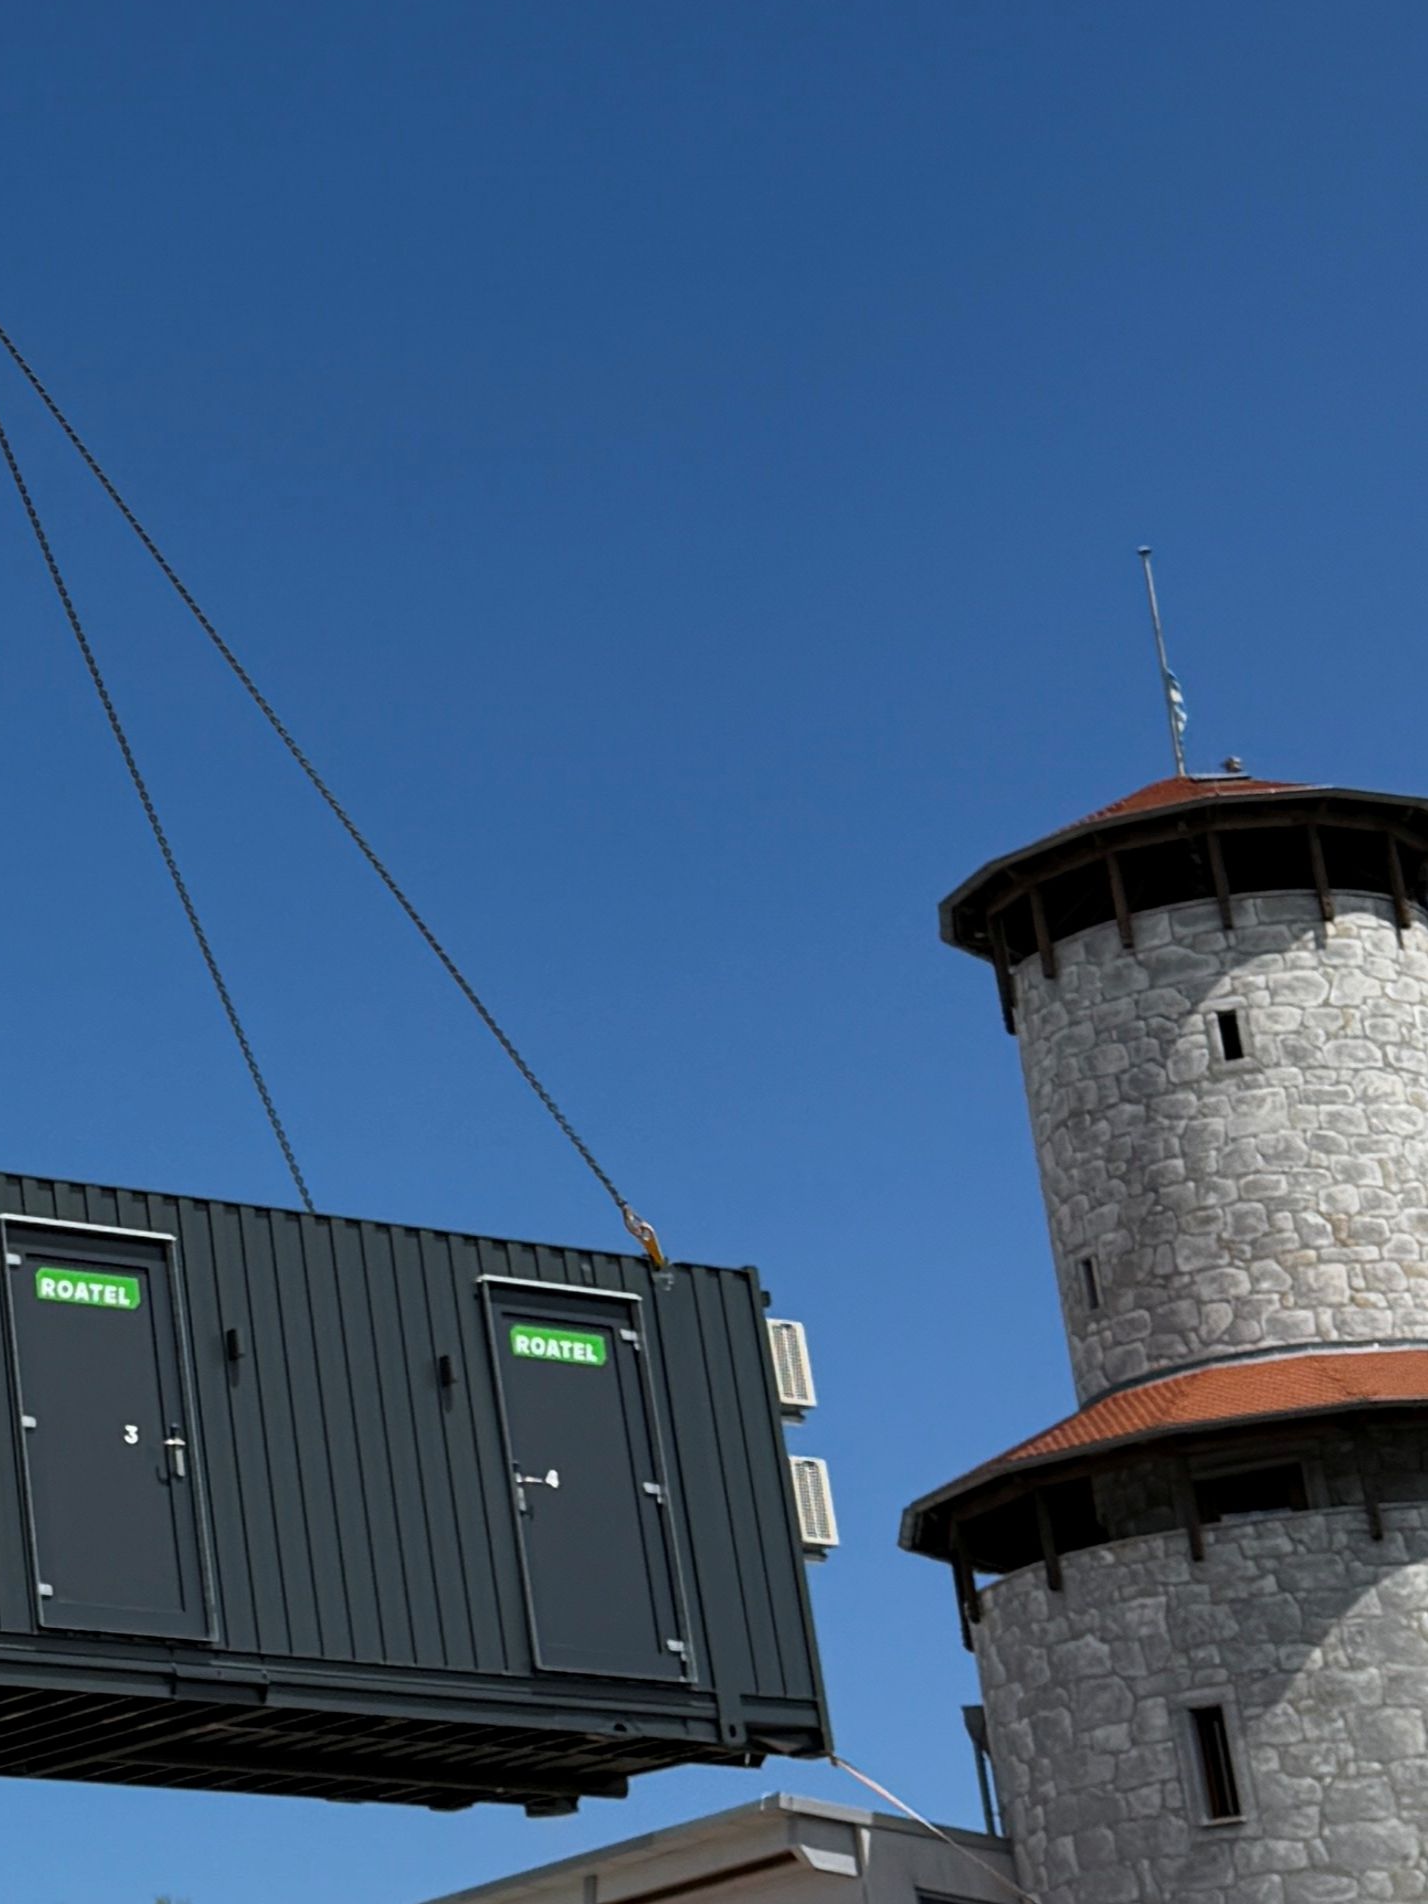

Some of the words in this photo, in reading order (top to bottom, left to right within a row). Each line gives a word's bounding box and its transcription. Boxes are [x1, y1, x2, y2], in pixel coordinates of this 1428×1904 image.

[40, 1276, 131, 1306] ROATEL
[514, 1335, 598, 1363] ROATEL
[123, 1424, 139, 1445] 3
